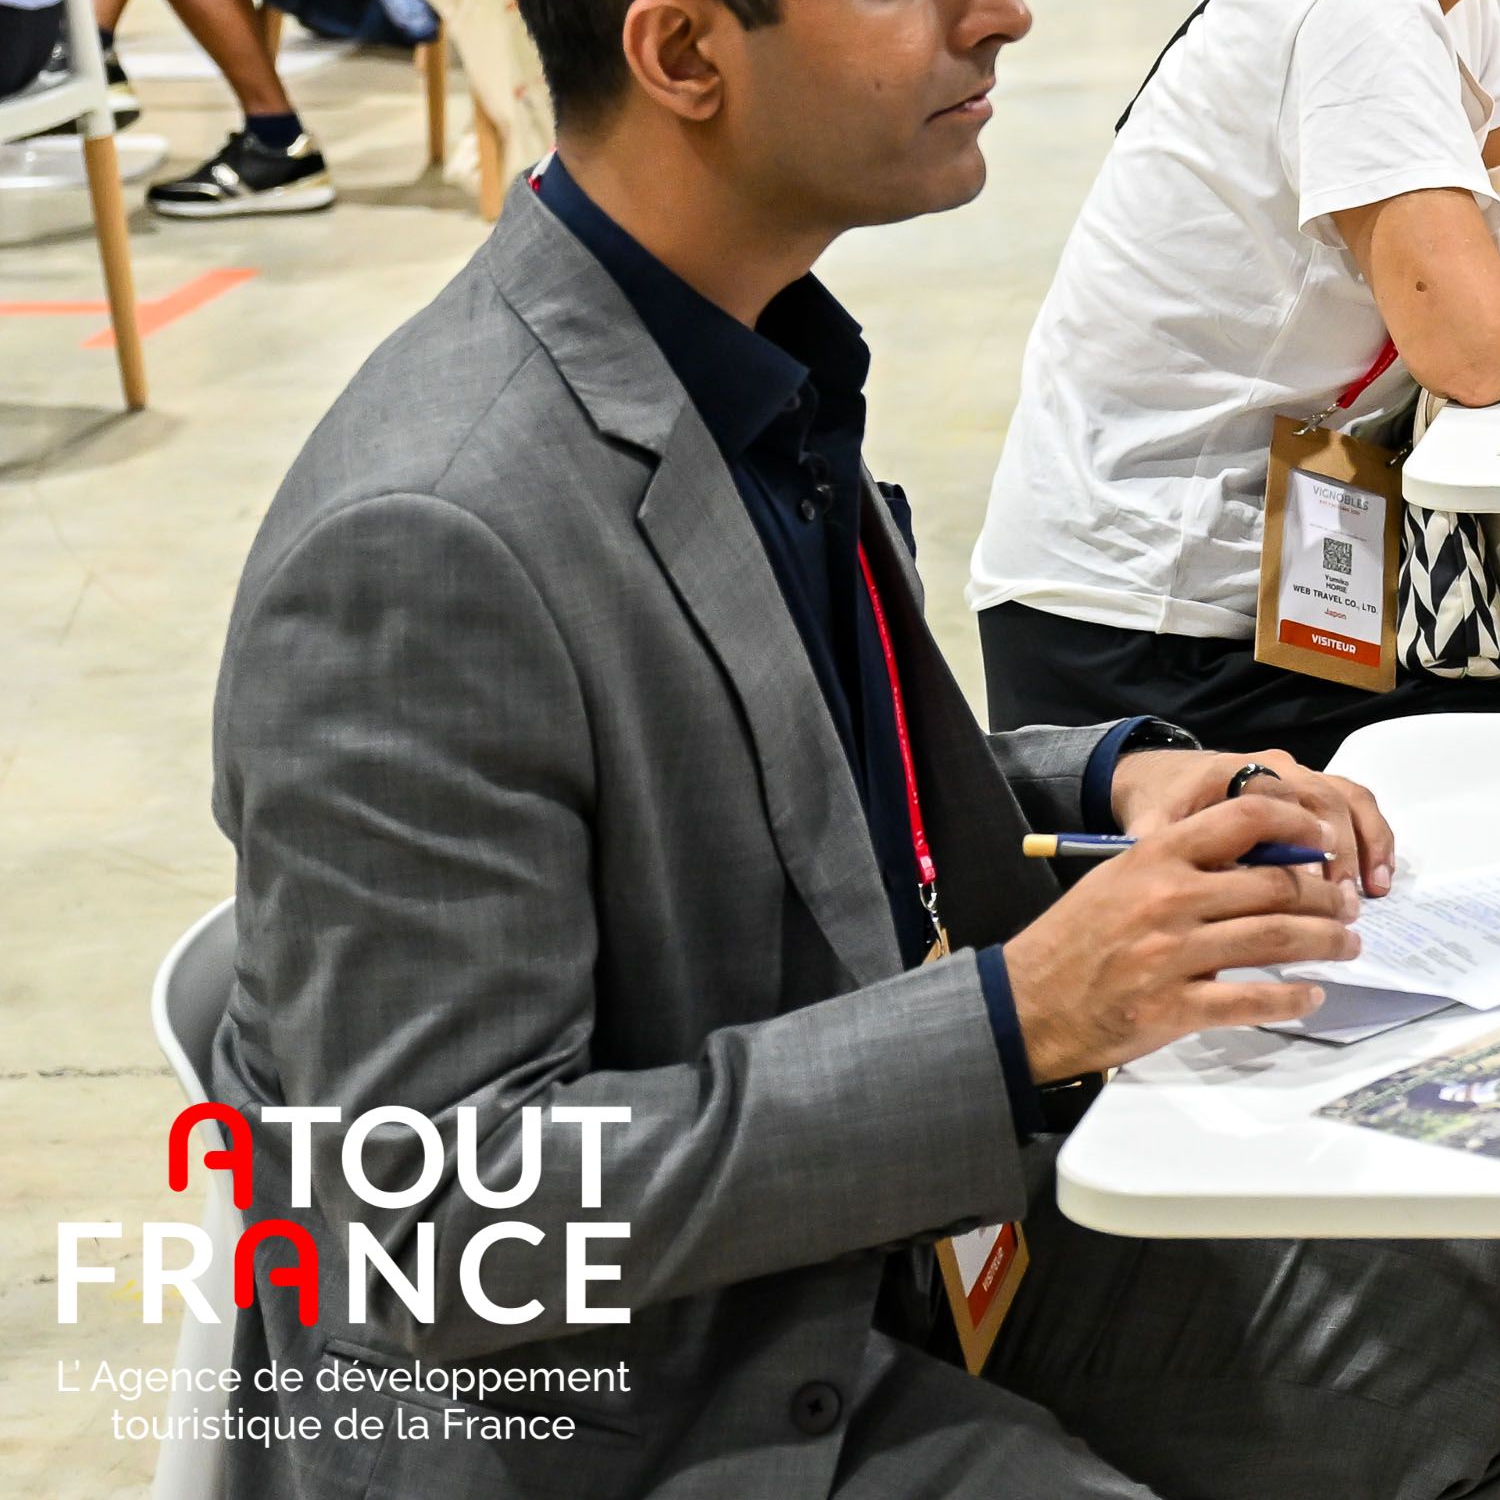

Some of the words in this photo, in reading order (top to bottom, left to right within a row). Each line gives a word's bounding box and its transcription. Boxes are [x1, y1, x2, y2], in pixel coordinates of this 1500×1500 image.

[1313, 486, 1369, 511] VIGNOBLES
[1293, 584, 1311, 595] WEB
[1313, 589, 1342, 604] TRAVEL
[1311, 633, 1357, 654] VISITEUR
